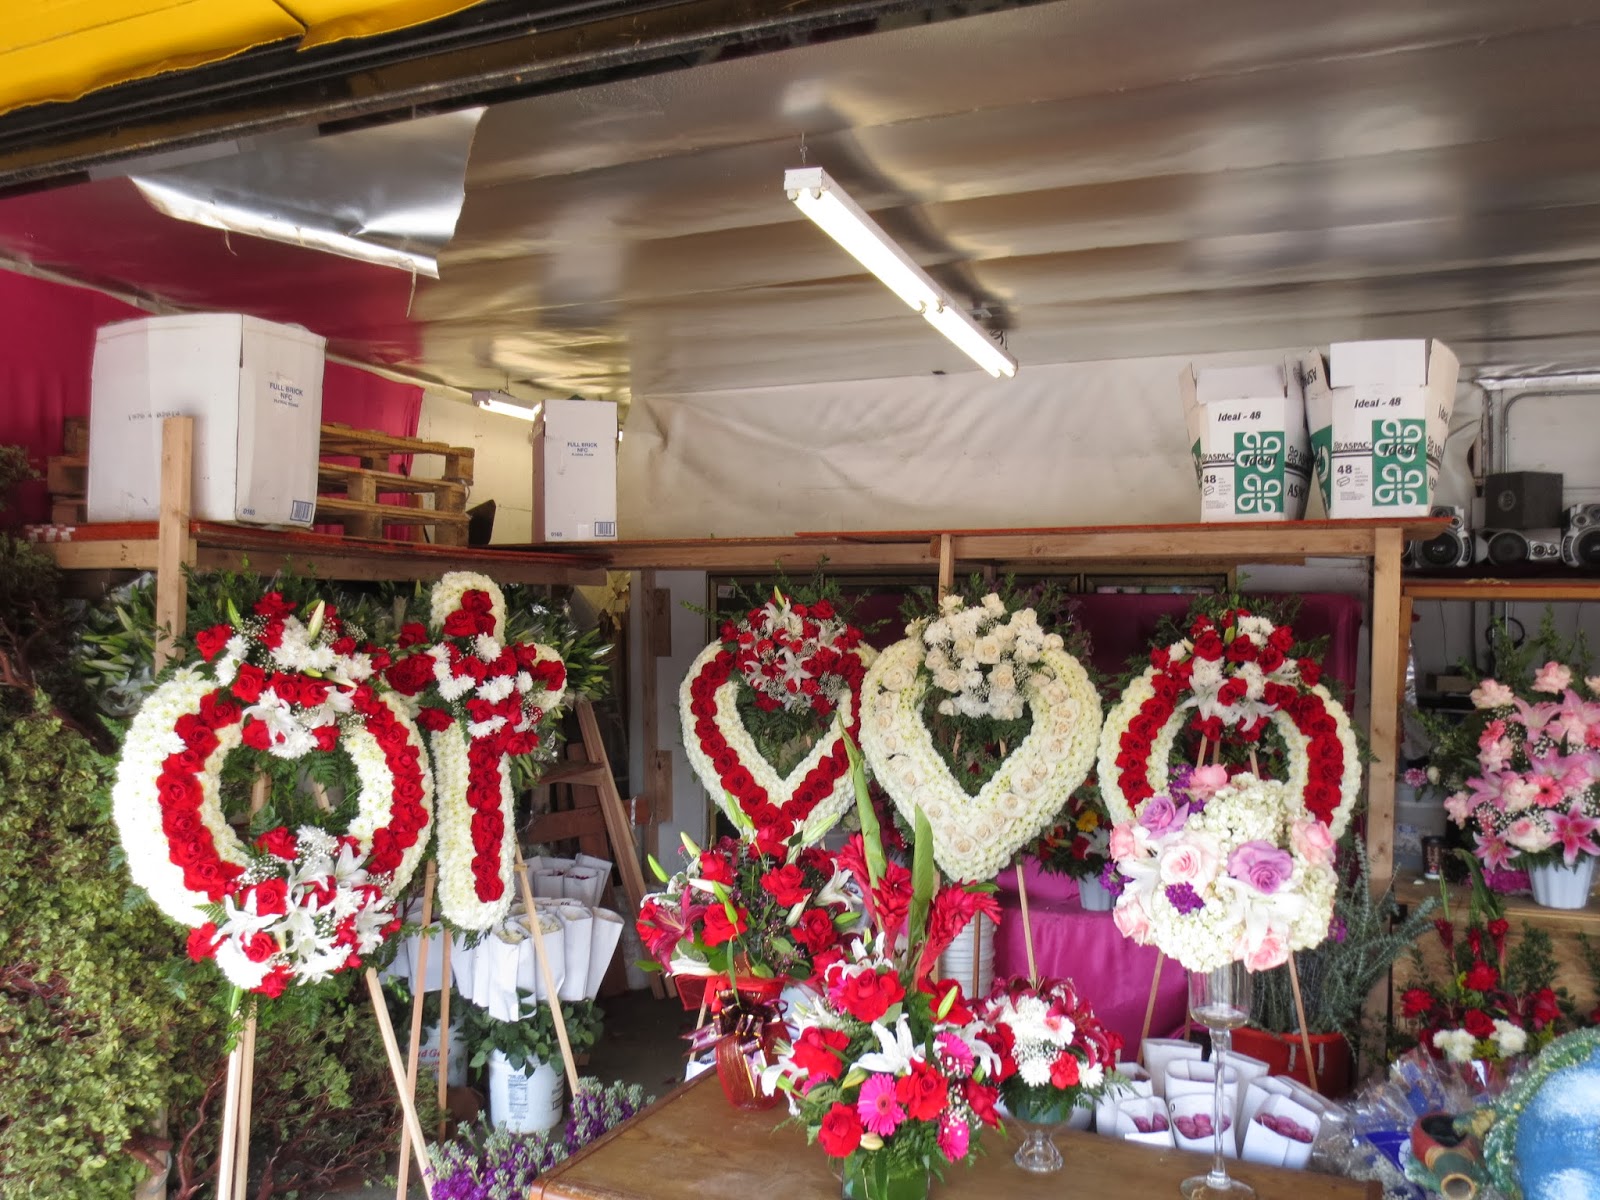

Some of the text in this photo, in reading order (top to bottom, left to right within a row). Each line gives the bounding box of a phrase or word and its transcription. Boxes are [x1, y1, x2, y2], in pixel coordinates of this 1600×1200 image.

[269, 382, 284, 391] FULL
[1354, 399, 1380, 409] Ideal
[1389, 397, 1402, 406] 48
[1218, 412, 1241, 422] Ideal
[1249, 410, 1262, 420] 48
[1343, 441, 1368, 450] ASPAC
[1383, 443, 1419, 456] Ideal
[1208, 453, 1232, 461] ASPAC
[1245, 454, 1278, 467] Ideal
[1337, 464, 1353, 475] 48
[1203, 475, 1217, 484] 48
